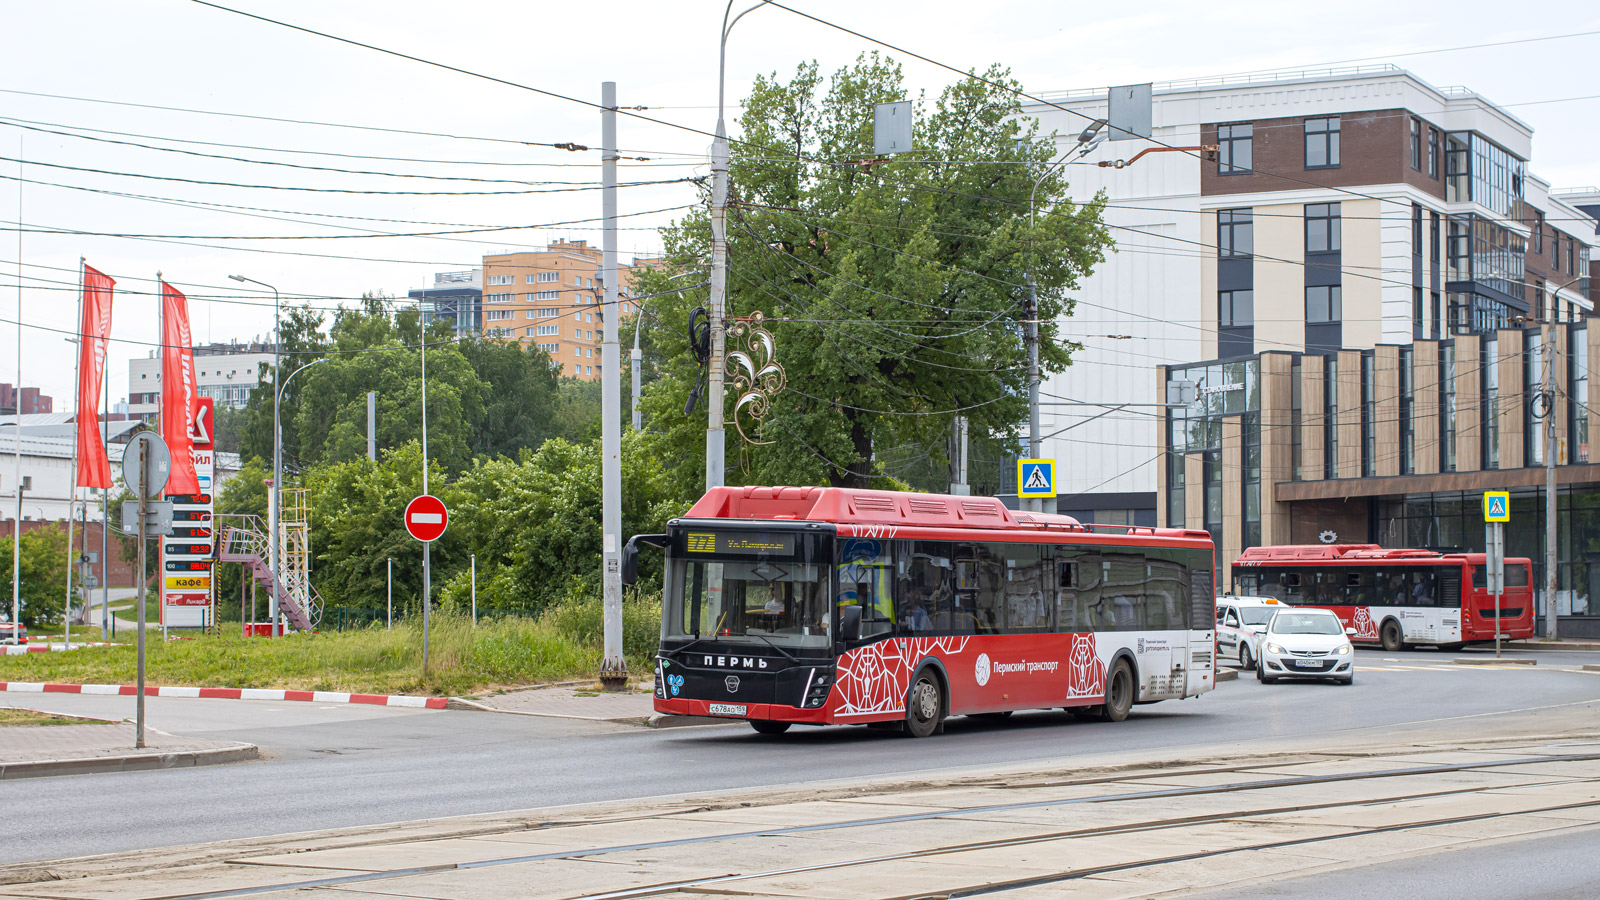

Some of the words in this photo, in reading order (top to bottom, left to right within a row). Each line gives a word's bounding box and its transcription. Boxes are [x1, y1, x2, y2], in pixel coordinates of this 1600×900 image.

[176, 578, 202, 586] кафе
[704, 655, 768, 668] ПЕРМЬ
[993, 659, 1026, 677] Пермский
[1026, 661, 1059, 675] транспорт
